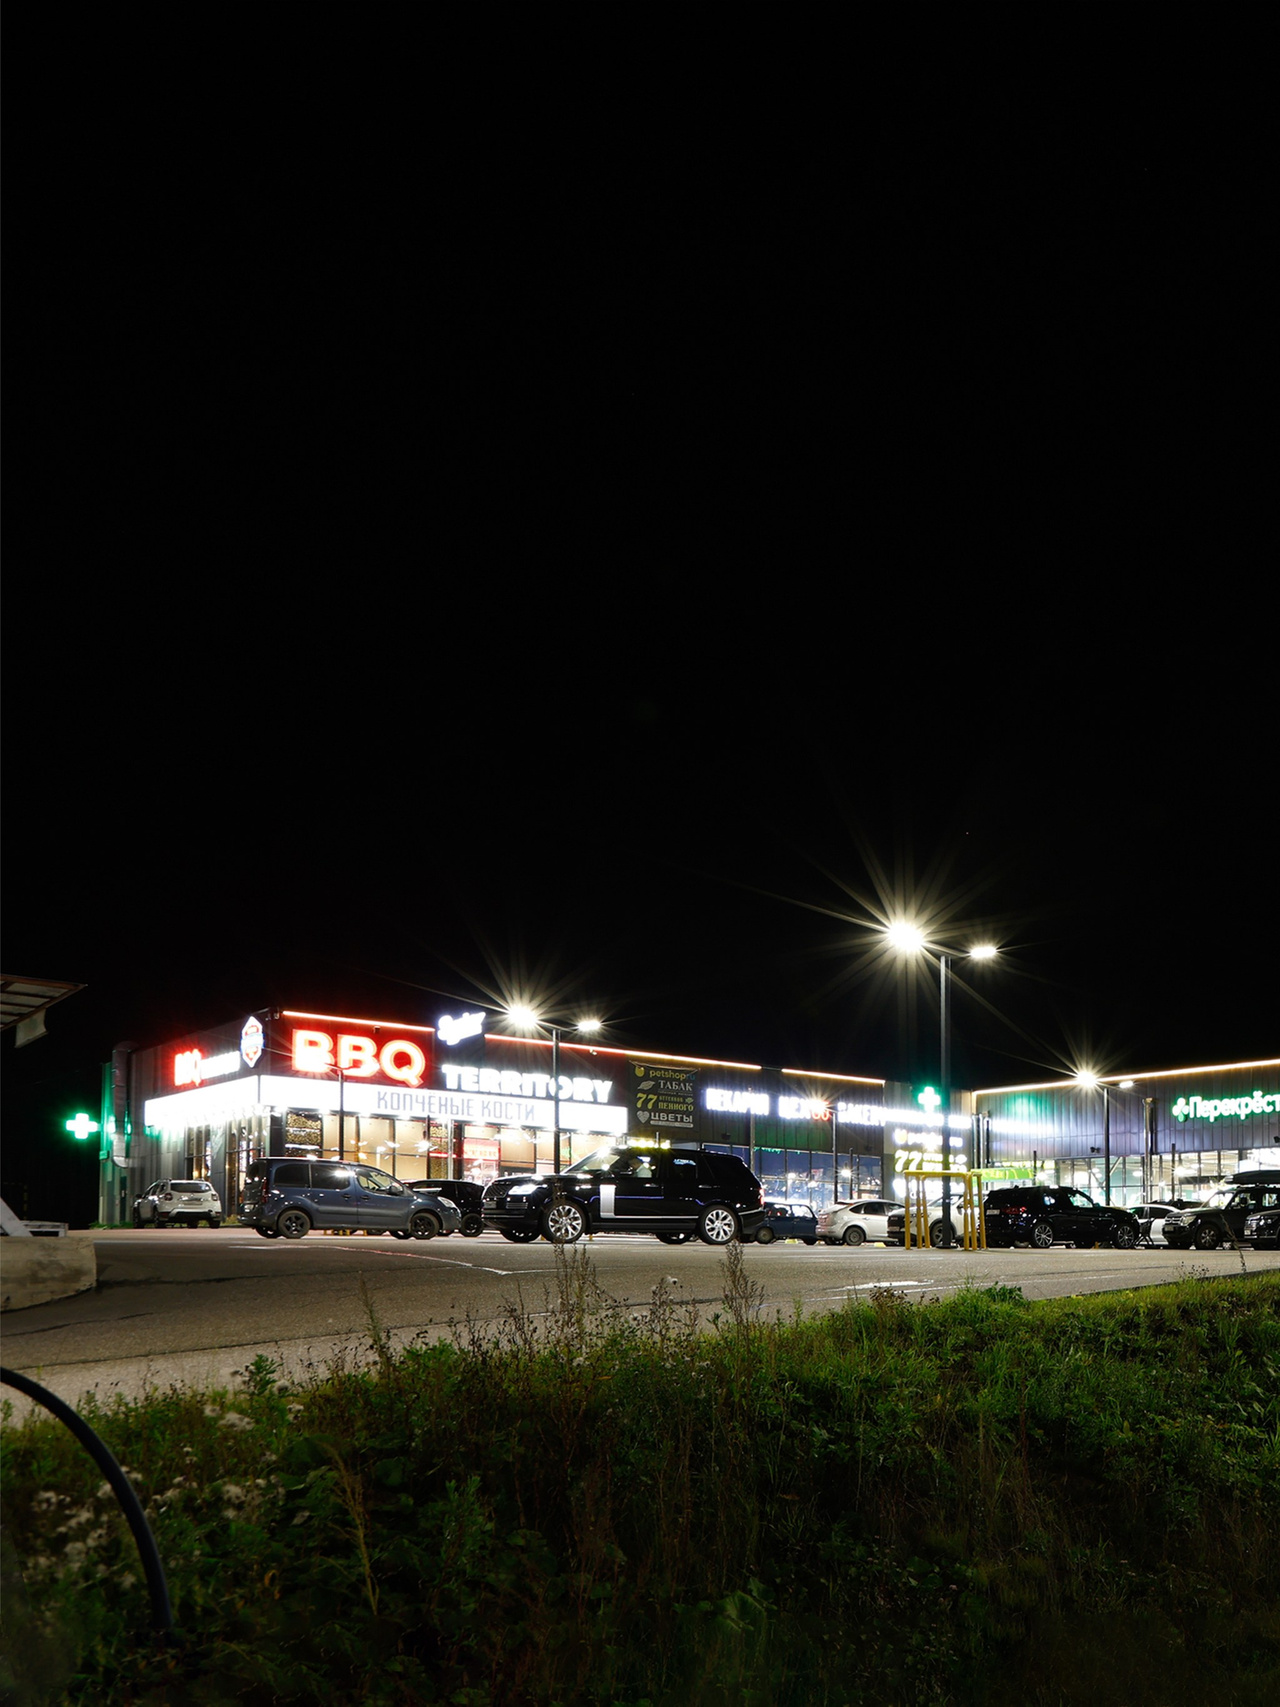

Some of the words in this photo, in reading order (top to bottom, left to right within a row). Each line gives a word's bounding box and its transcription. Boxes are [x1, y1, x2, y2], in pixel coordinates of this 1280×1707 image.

[292, 1029, 426, 1089] BBQ
[441, 1064, 613, 1104] TERRITORY
[659, 1080, 693, 1092] ТАБАК
[377, 1090, 474, 1117] КОПЧЁНЫЕ
[481, 1100, 535, 1121] КОСТИ
[636, 1092, 658, 1109] 77
[650, 1112, 693, 1123] ЦВЕТЫ
[895, 1150, 922, 1172] 77
